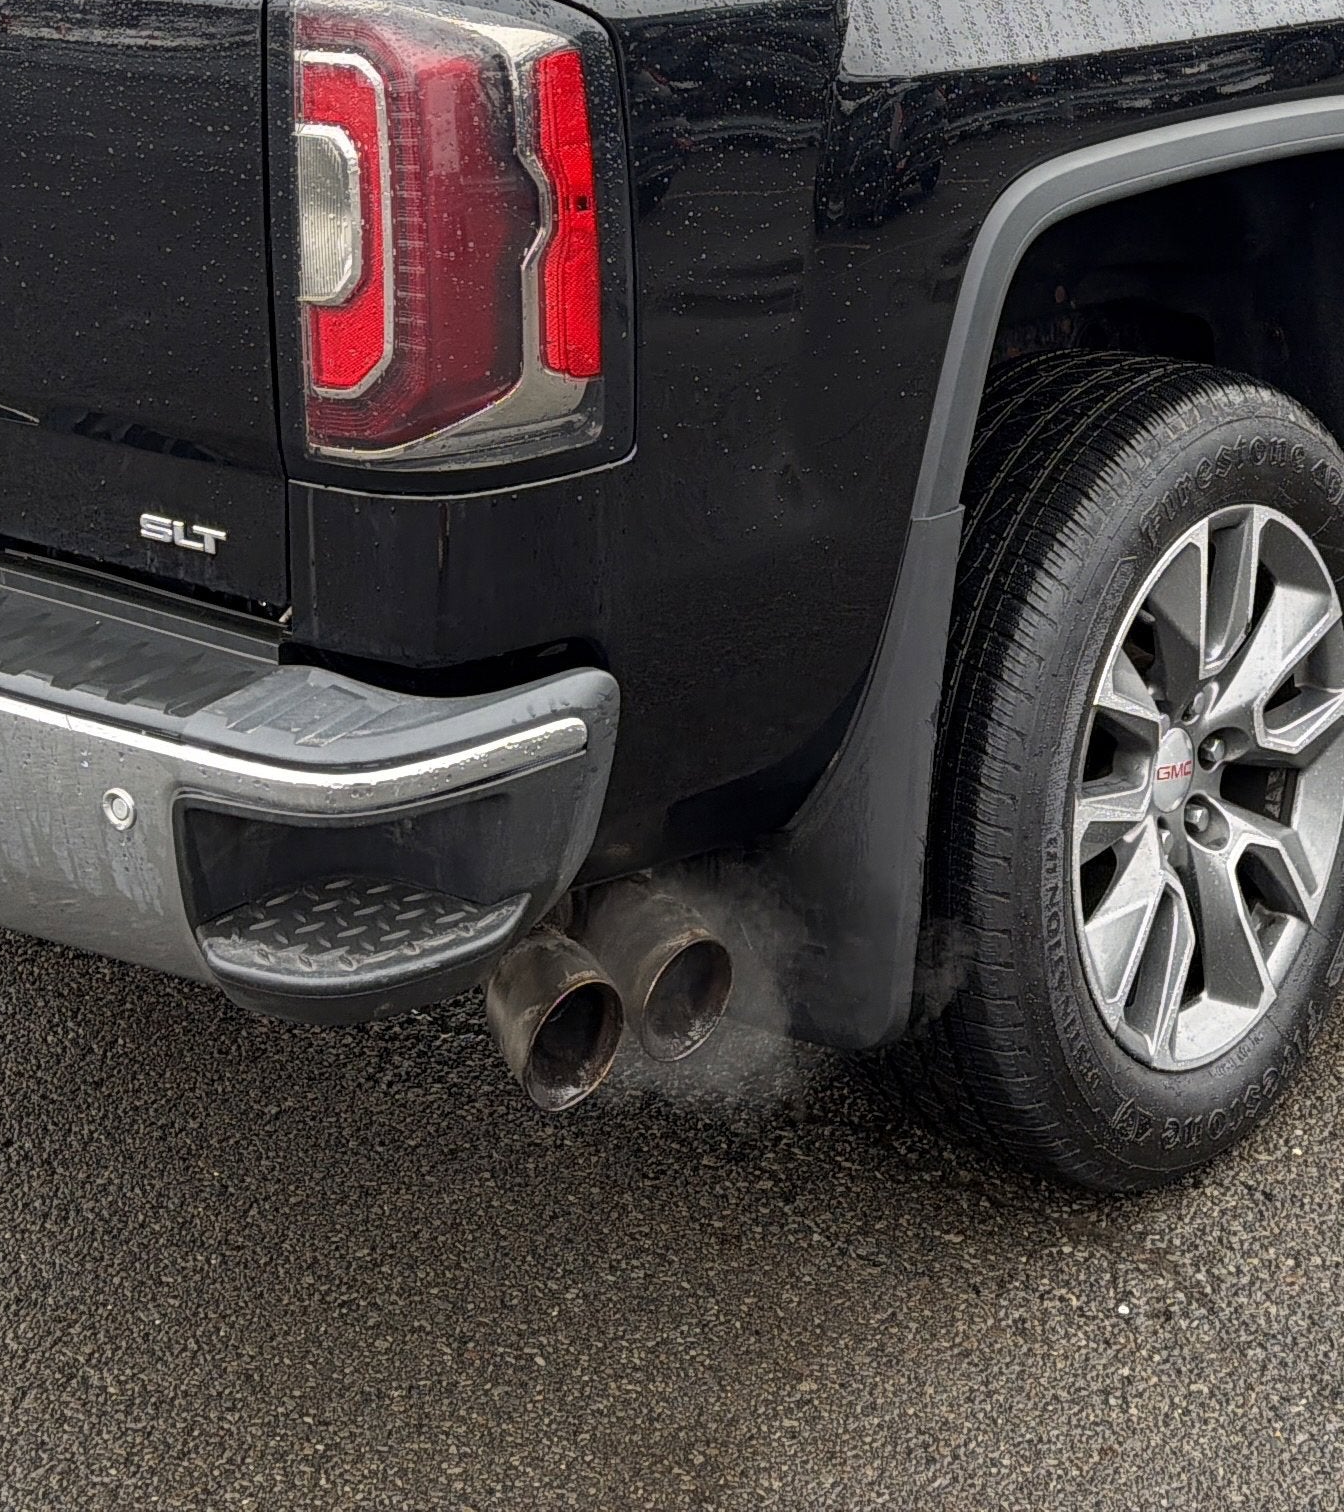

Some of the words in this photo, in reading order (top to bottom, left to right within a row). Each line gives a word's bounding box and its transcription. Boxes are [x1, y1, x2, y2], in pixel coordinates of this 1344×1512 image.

[1139, 434, 1307, 552] Firestone
[139, 513, 227, 555] SLT
[1156, 760, 1192, 780] GMC
